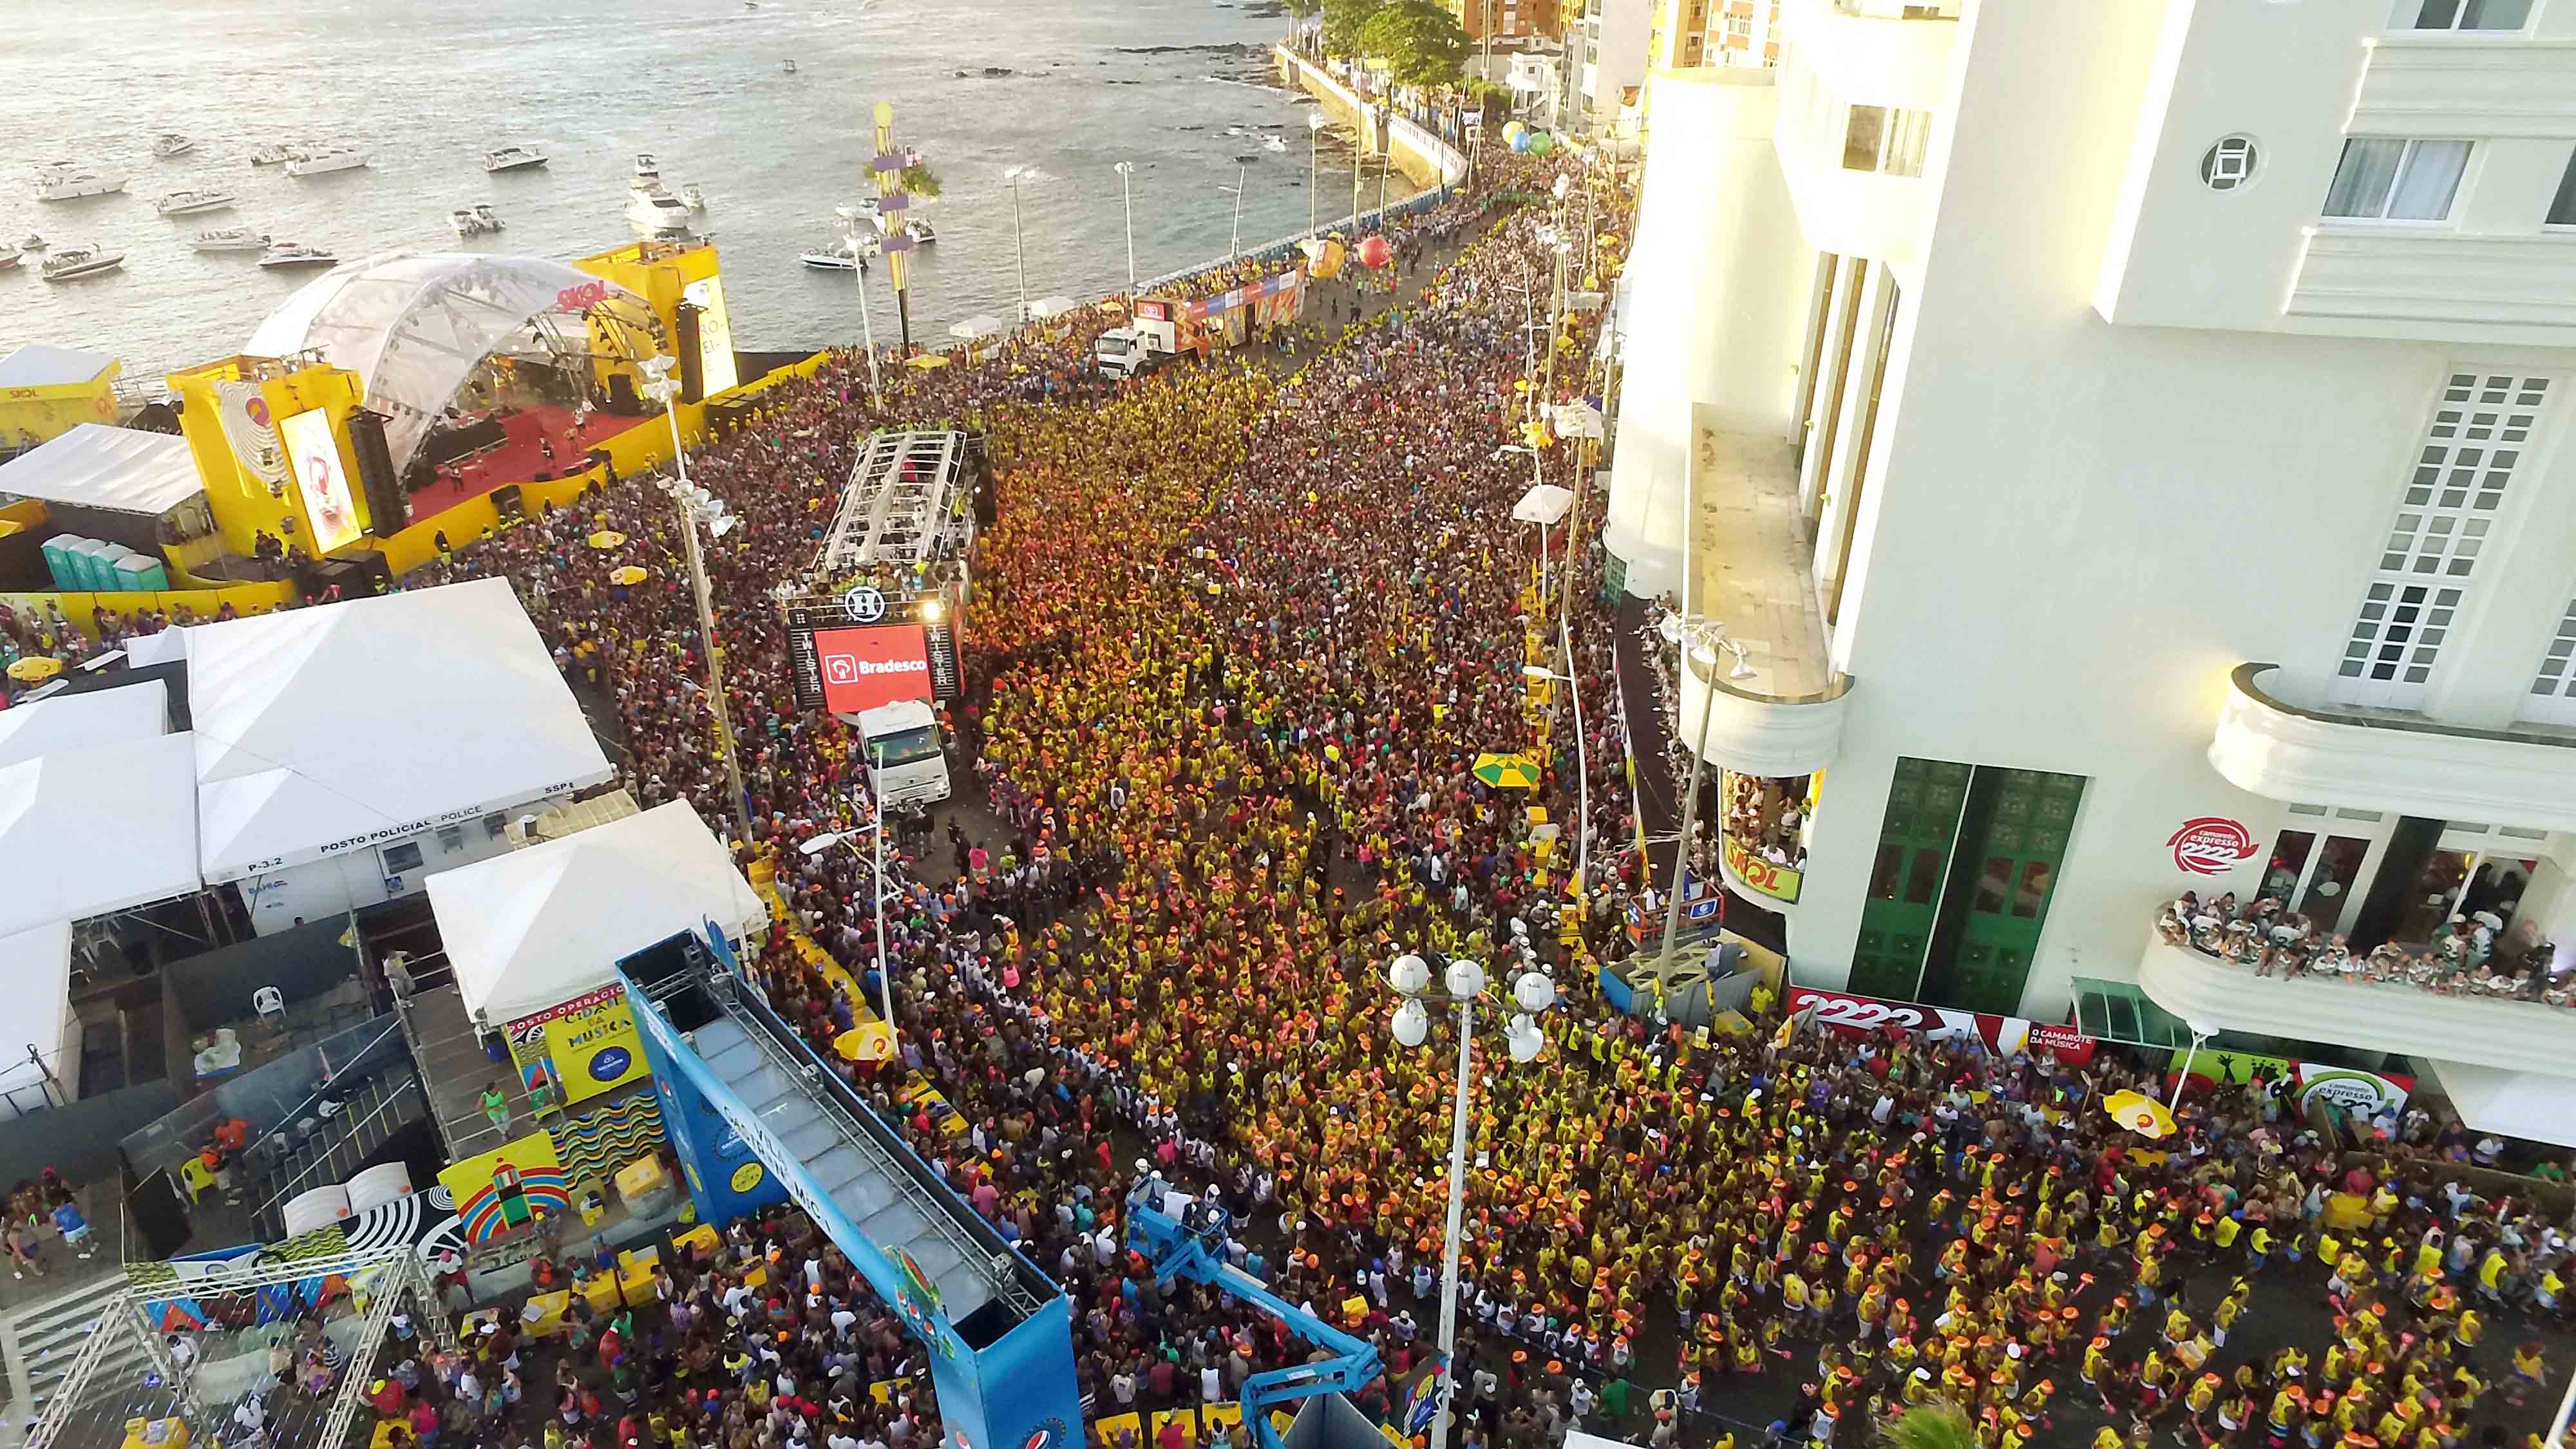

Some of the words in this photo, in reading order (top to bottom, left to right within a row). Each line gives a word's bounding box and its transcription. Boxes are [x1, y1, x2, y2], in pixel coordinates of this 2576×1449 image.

[929, 624, 949, 685] TWISTER
[802, 632, 821, 693] TWISTER
[858, 659, 927, 675] Bradesco
[321, 836, 366, 853] POSTO
[370, 820, 432, 840] POLICIAL
[440, 806, 483, 822] POLICE
[2190, 835, 2239, 848] expresso
[2182, 842, 2240, 859] 2222
[248, 857, 283, 872] P-3.2
[2030, 1036, 2043, 1045] DA
[2040, 1030, 2092, 1045] CAMAROTE
[2318, 1086, 2373, 1101] expresso
